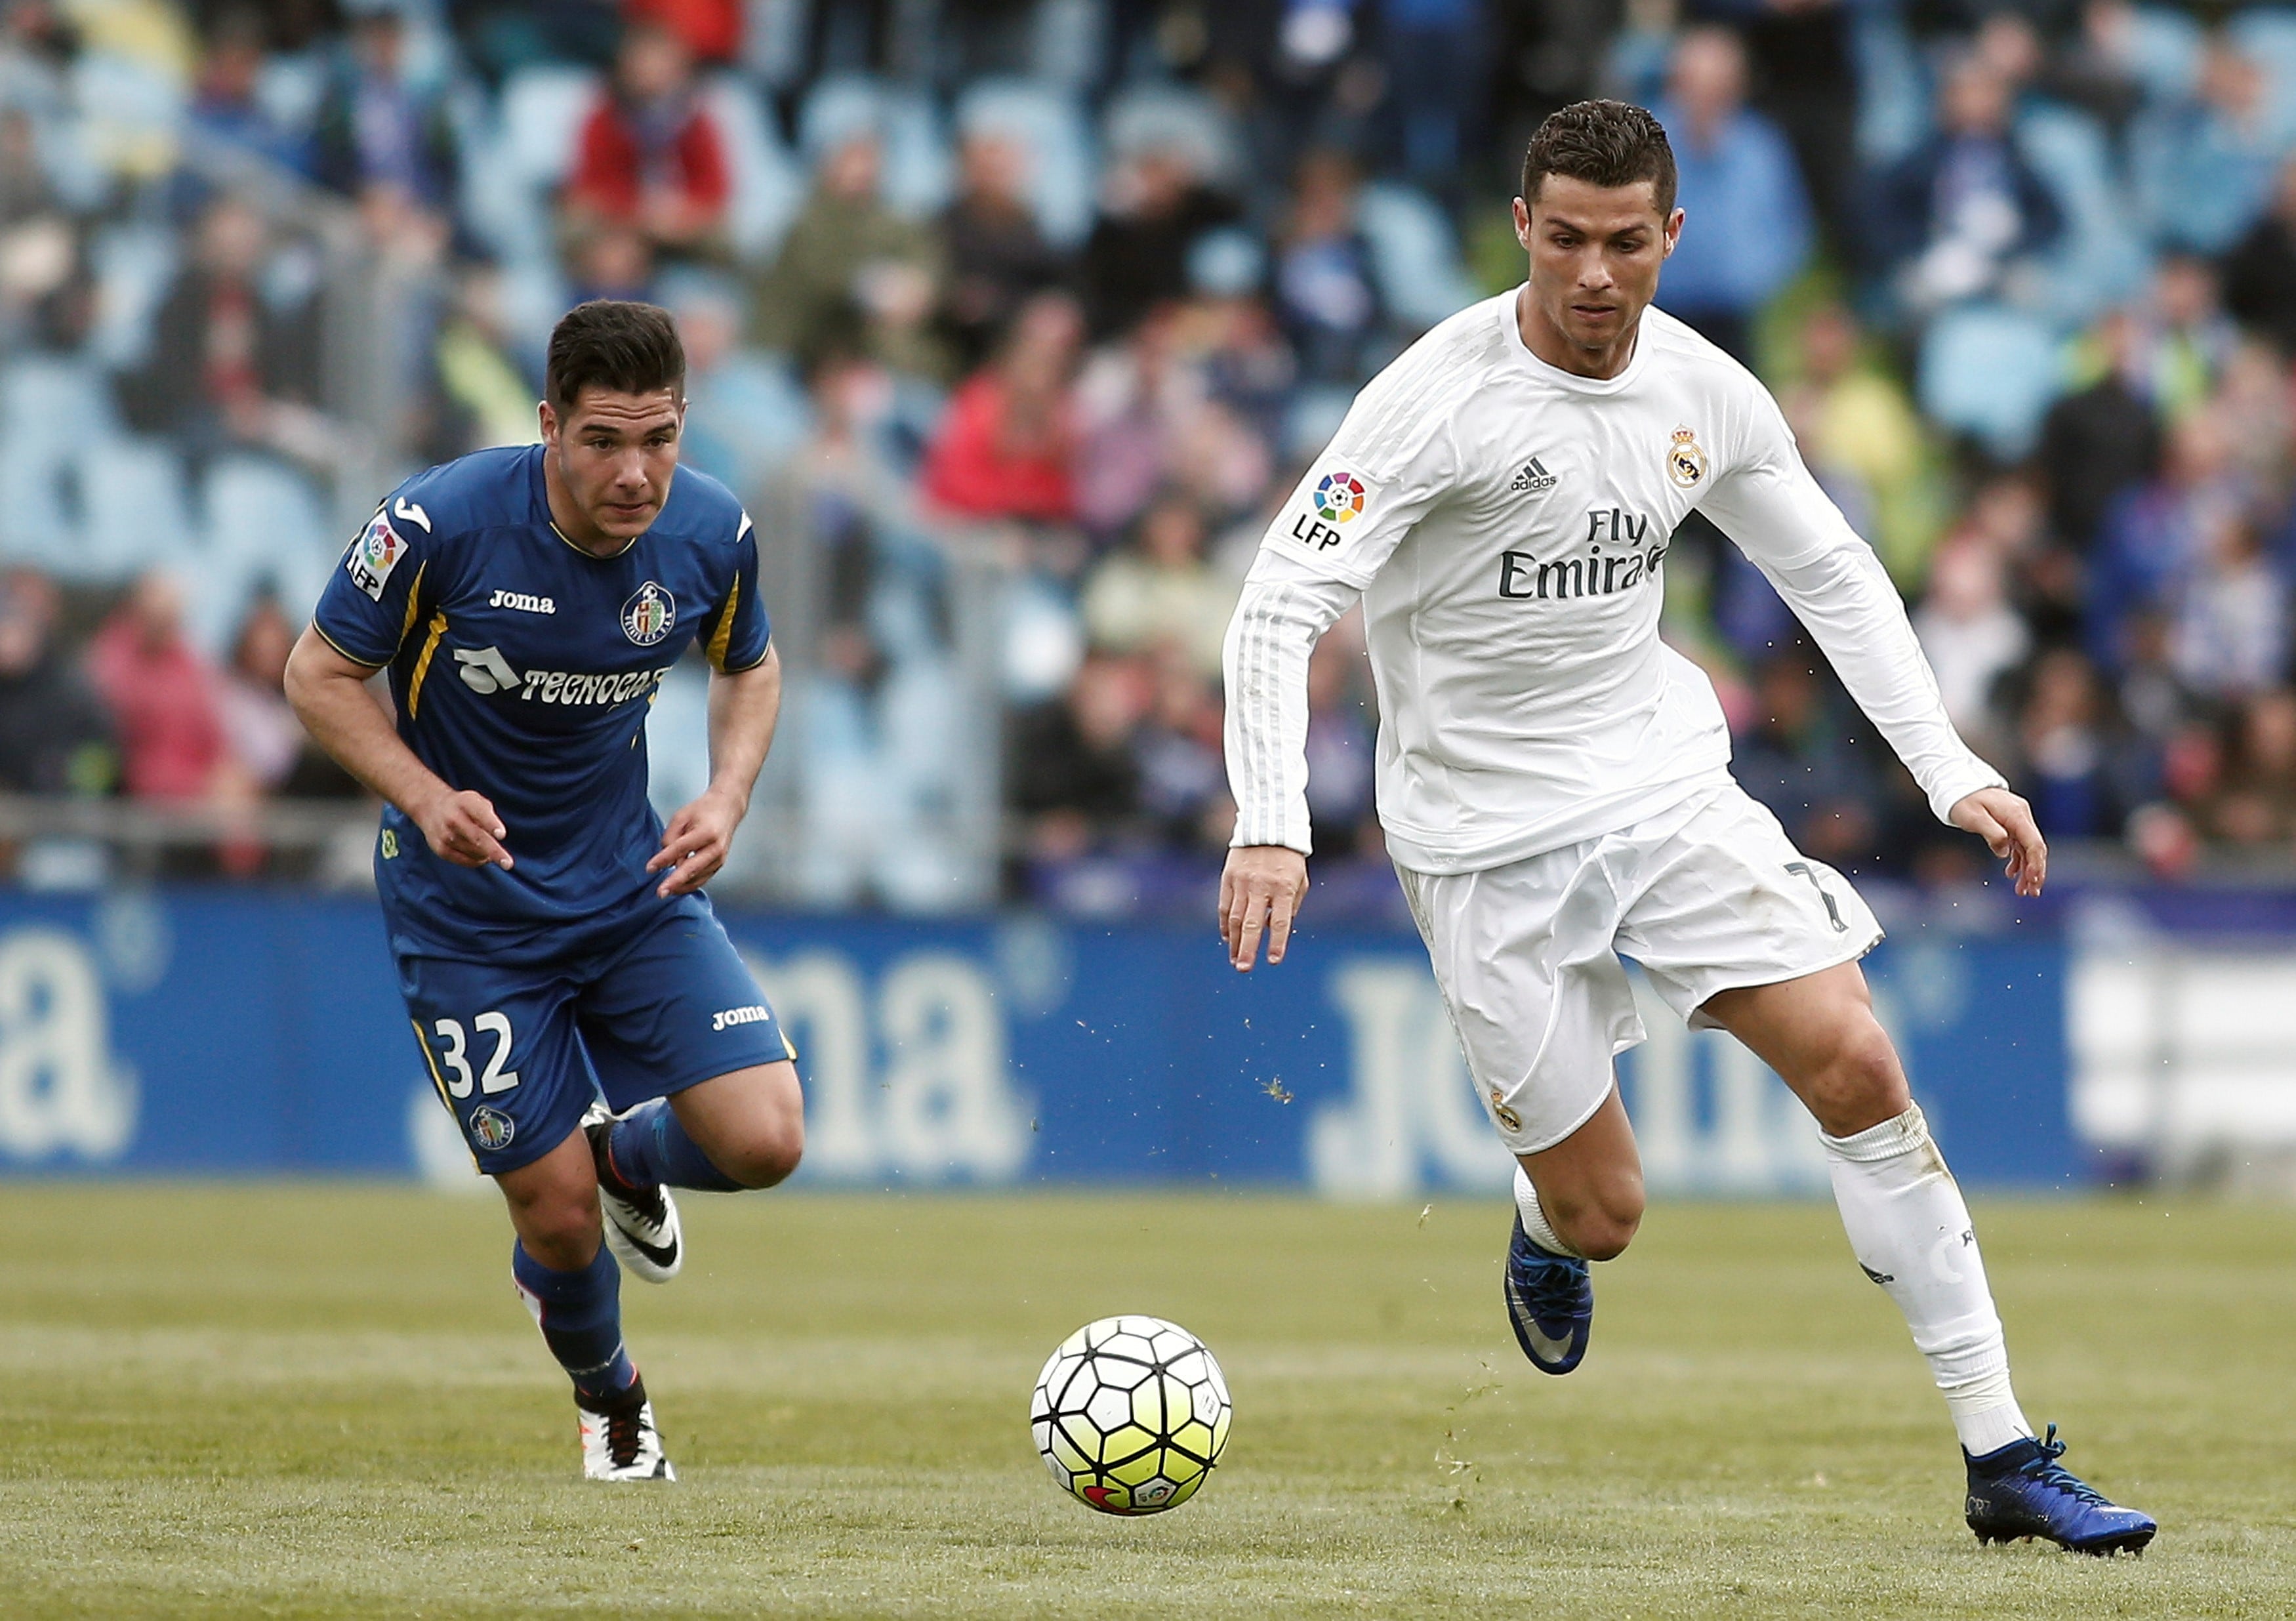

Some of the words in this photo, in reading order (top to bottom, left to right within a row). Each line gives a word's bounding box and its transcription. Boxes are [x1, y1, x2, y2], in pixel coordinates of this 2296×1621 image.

[1511, 476, 1557, 491] adidas
[1292, 513, 1342, 551] LFP
[1586, 508, 1648, 547] Fly
[489, 589, 556, 615] Joma
[1782, 861, 1850, 934] 7
[712, 1005, 769, 1031] Joma
[434, 1011, 520, 1099] 32
